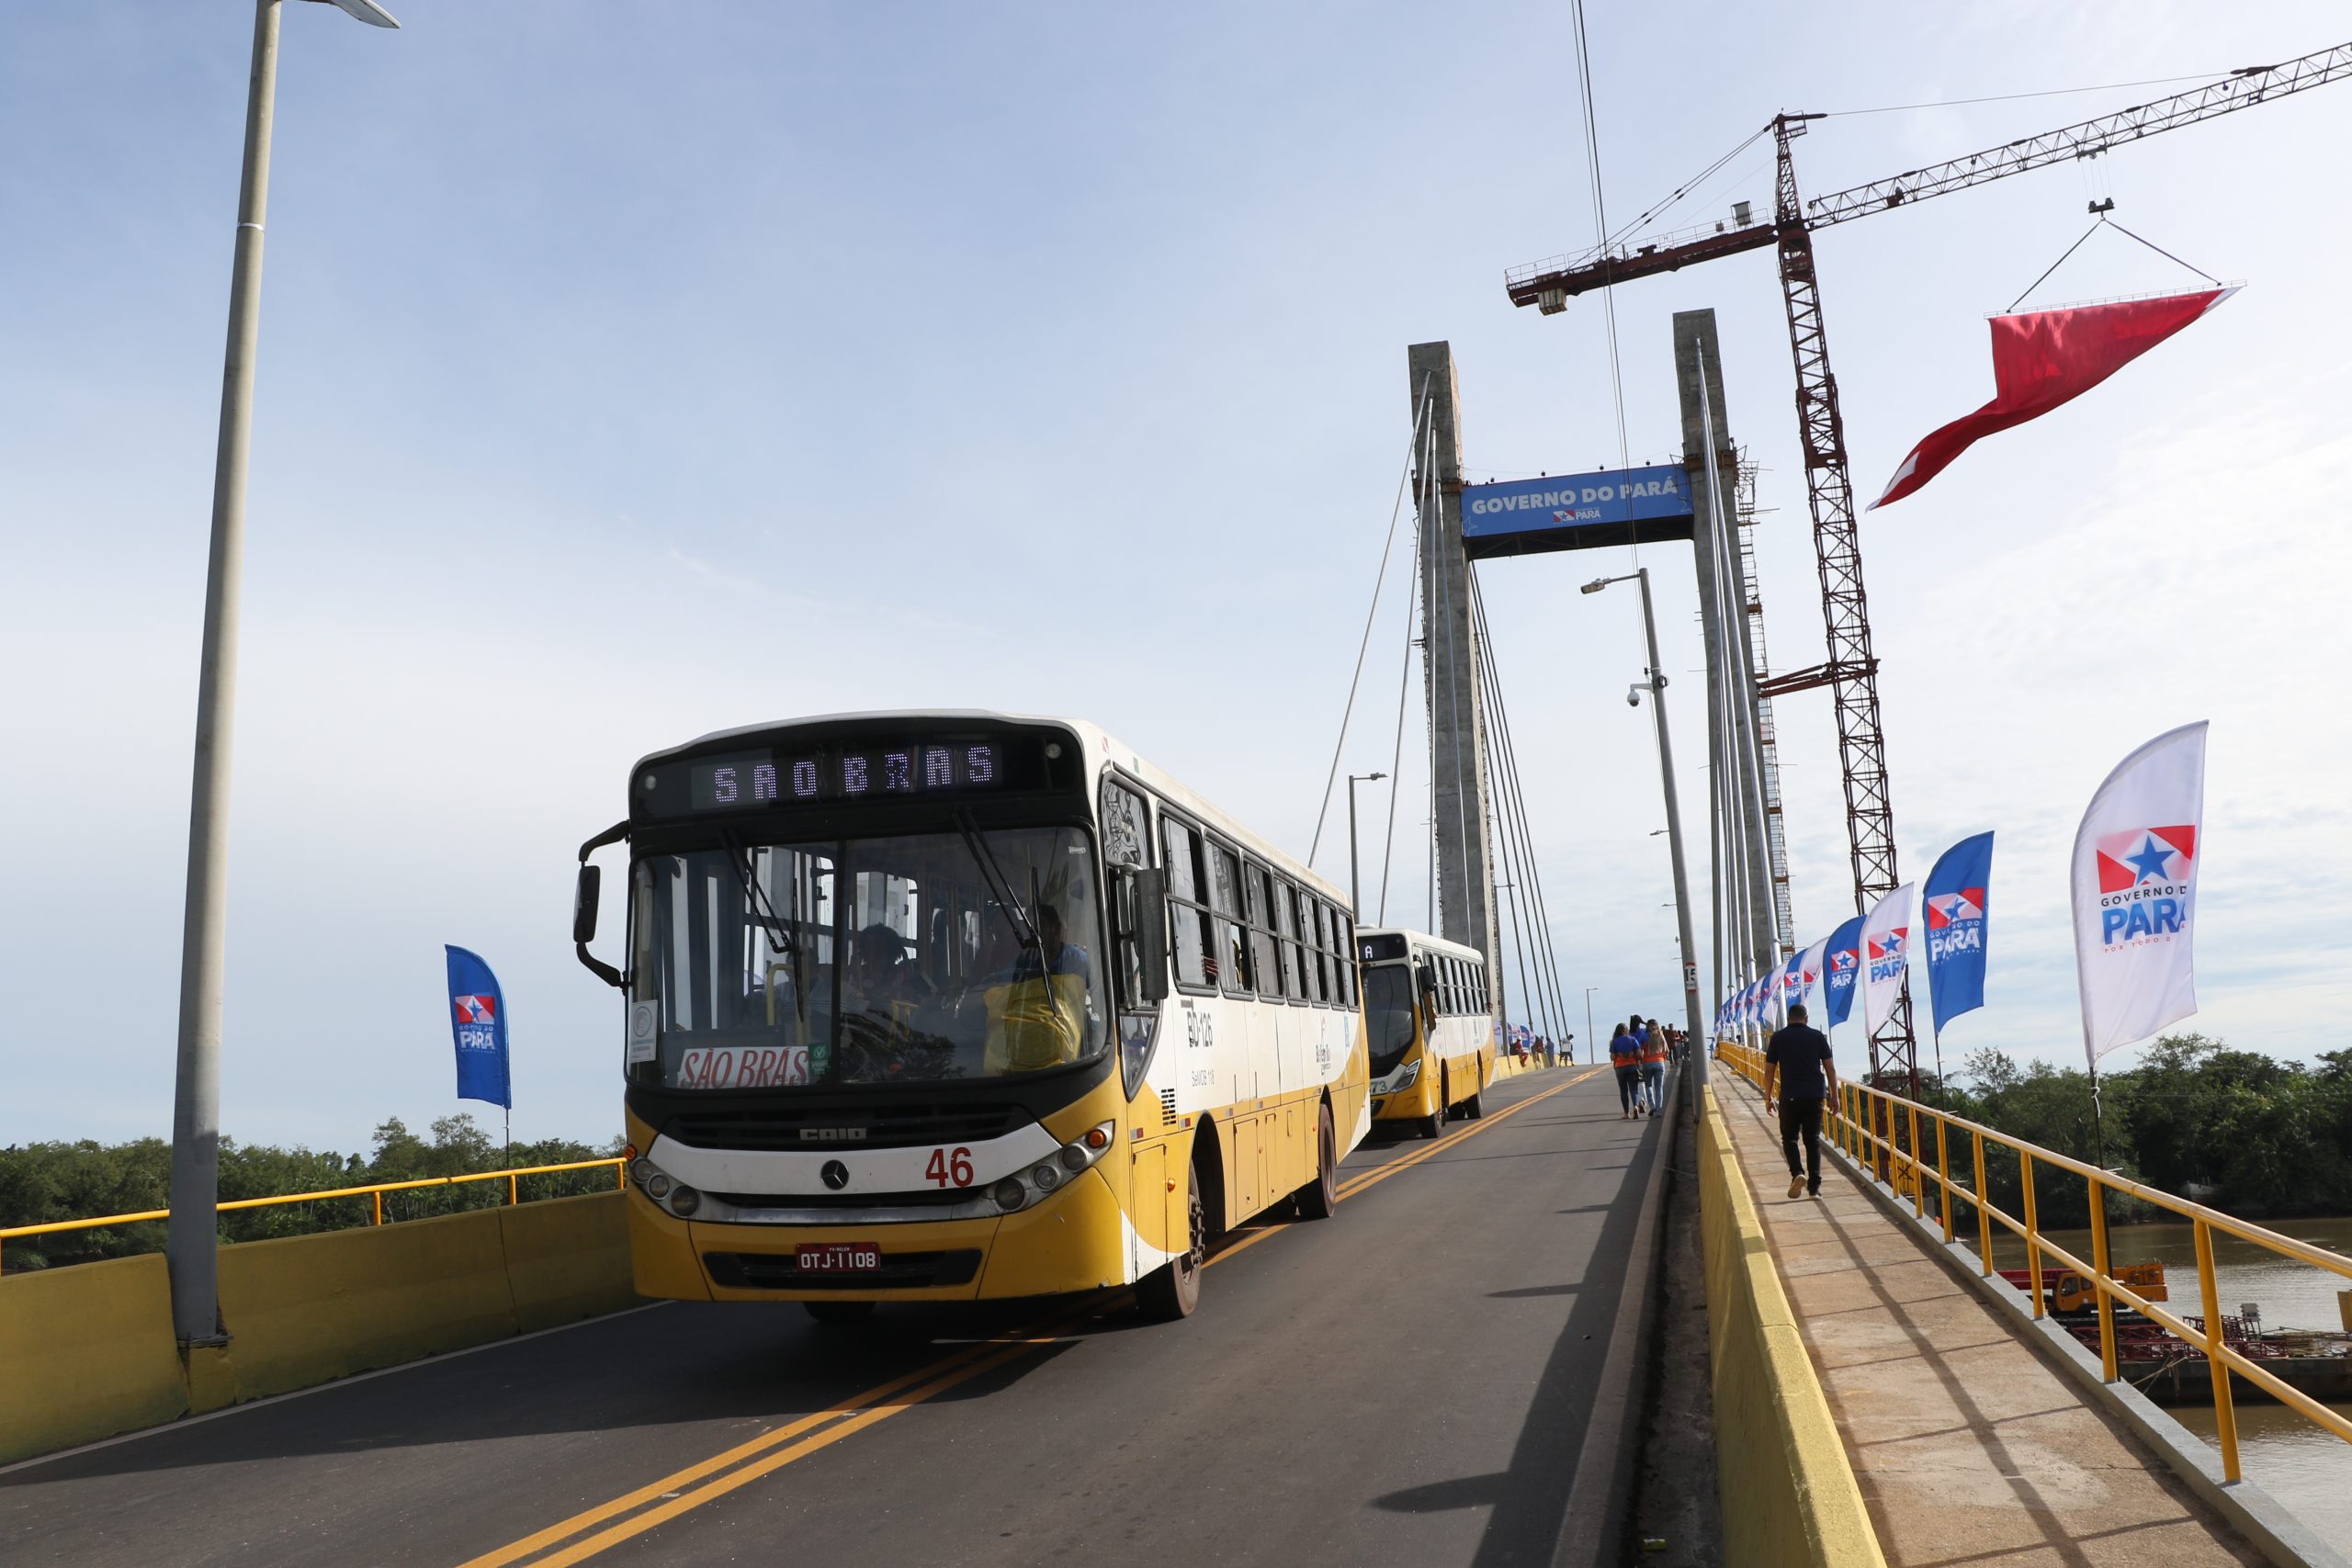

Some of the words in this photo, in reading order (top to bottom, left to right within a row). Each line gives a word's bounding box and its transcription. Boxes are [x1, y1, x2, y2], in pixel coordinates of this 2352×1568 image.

[1472, 490, 1577, 514] GOVERNO
[1581, 486, 1614, 503] DO
[1619, 476, 1678, 500] PARÁ
[715, 760, 817, 803] SAO
[843, 746, 993, 794] BRAS
[2100, 886, 2174, 908] GOVERNO
[1364, 945, 1374, 959] A
[679, 1047, 733, 1089] SÃO
[737, 1045, 809, 1088] BRÁS
[799, 1128, 866, 1141] CAIO
[925, 1146, 974, 1188] 46
